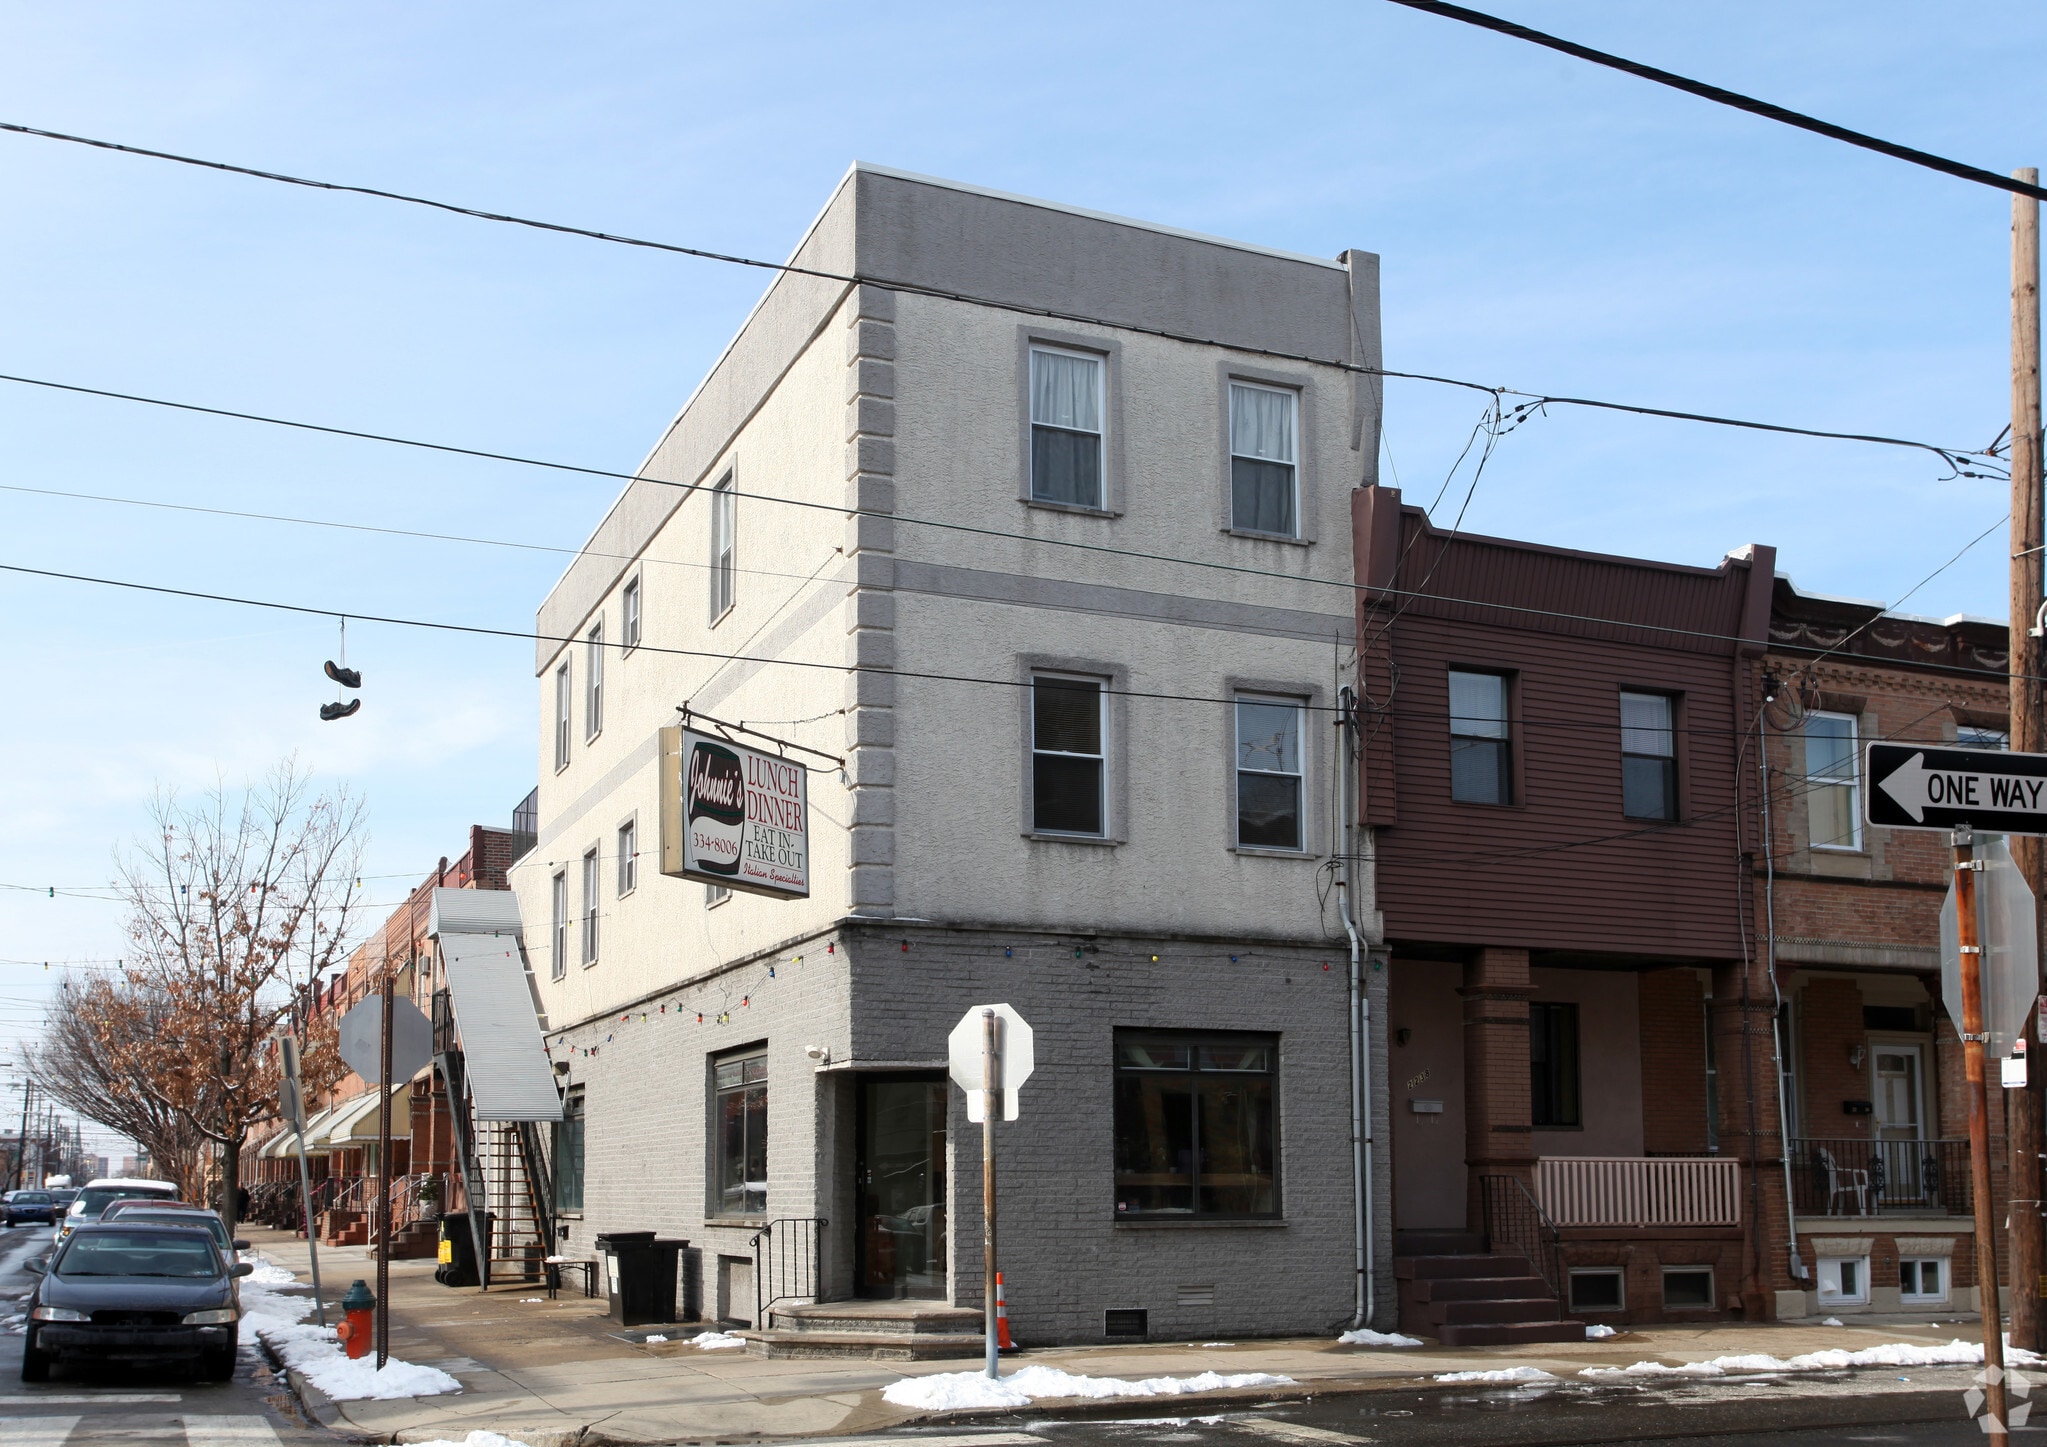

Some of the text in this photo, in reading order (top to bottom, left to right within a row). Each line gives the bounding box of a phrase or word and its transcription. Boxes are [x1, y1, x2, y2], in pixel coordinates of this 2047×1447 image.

[689, 750, 744, 814] Johnnie's
[748, 755, 799, 798] LUNCH
[1928, 774, 2044, 809] ONE WAY
[746, 790, 803, 832] DINNER
[694, 832, 738, 856] 334-8006
[753, 825, 776, 845] EAT
[745, 840, 803, 869] TAKE OUT
[743, 862, 805, 886] Italian Specialties
